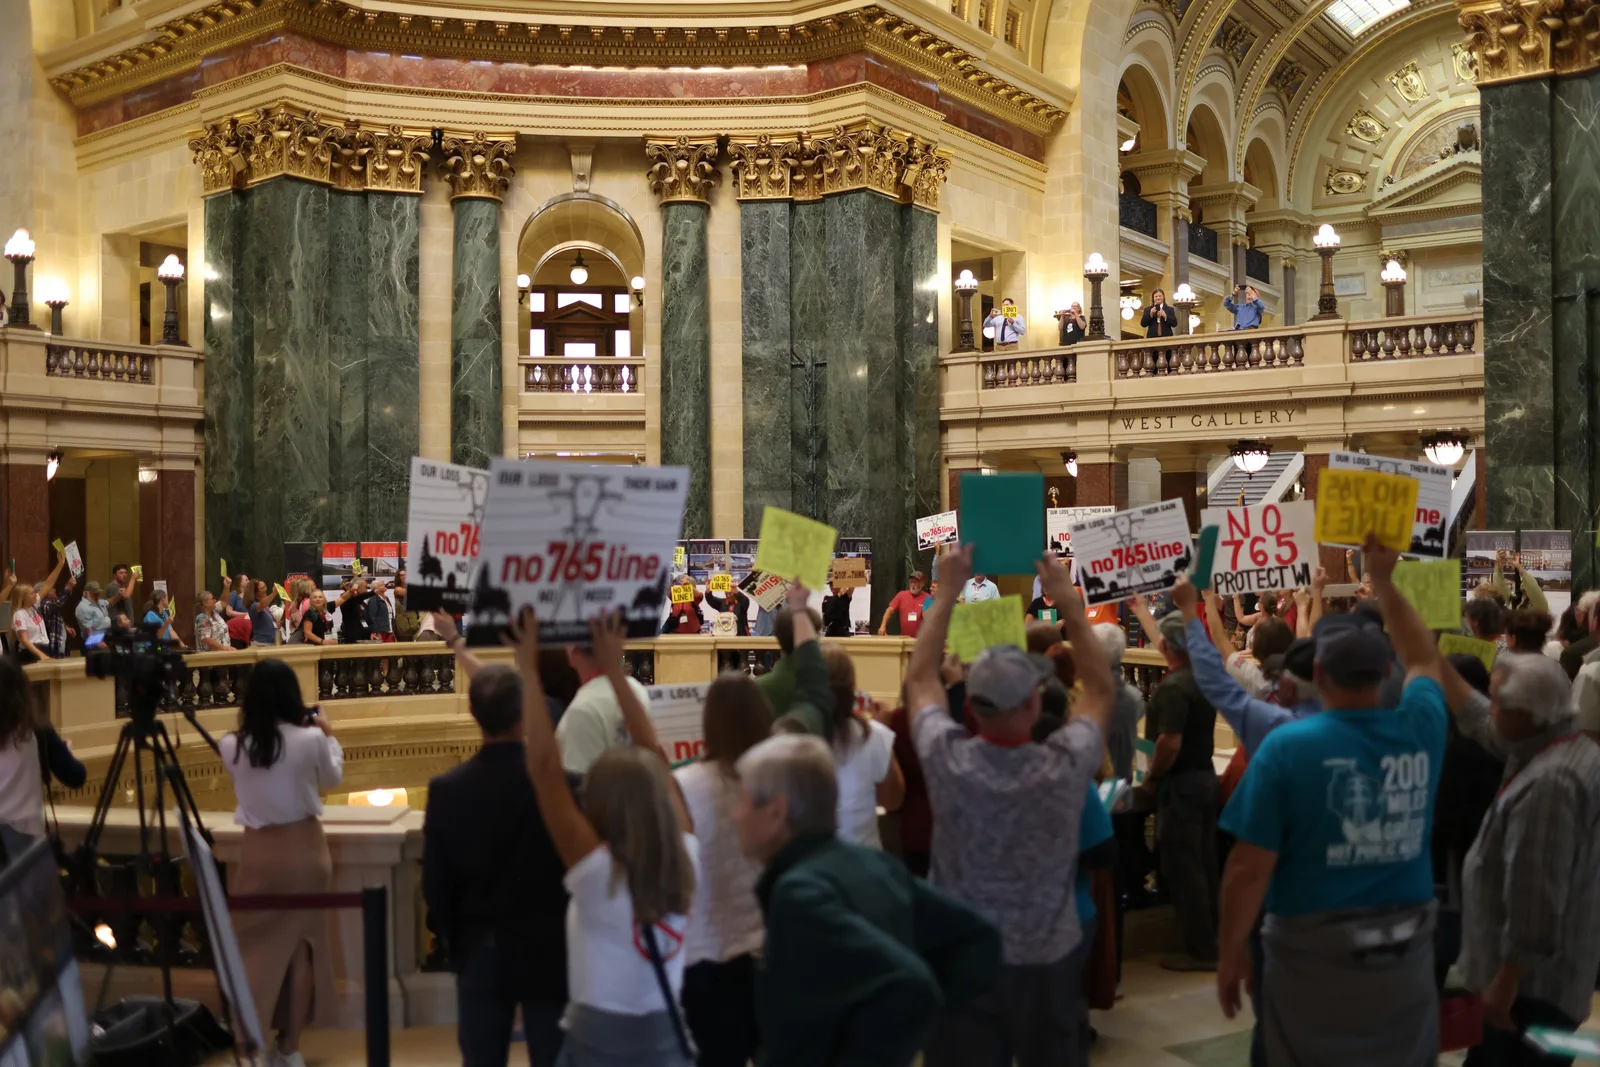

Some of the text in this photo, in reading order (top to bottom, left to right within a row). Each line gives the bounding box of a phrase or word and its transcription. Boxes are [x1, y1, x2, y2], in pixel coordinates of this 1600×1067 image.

[1122, 409, 1296, 430] WEST GALLERY
[421, 464, 460, 481] OUR LOSS
[1336, 454, 1447, 476] OUR LOSS THEIR GAIN
[1141, 507, 1159, 516] THEIR
[1161, 503, 1176, 512] GAIN
[1226, 504, 1282, 540] NO
[502, 541, 661, 584] no765line
[1090, 541, 1184, 574] no765line
[1221, 532, 1298, 571] 765
[1116, 564, 1161, 579] NO NEED
[1214, 562, 1311, 594] PROTECT WI
[670, 686, 698, 700] LOSS
[1381, 751, 1430, 792] 200
